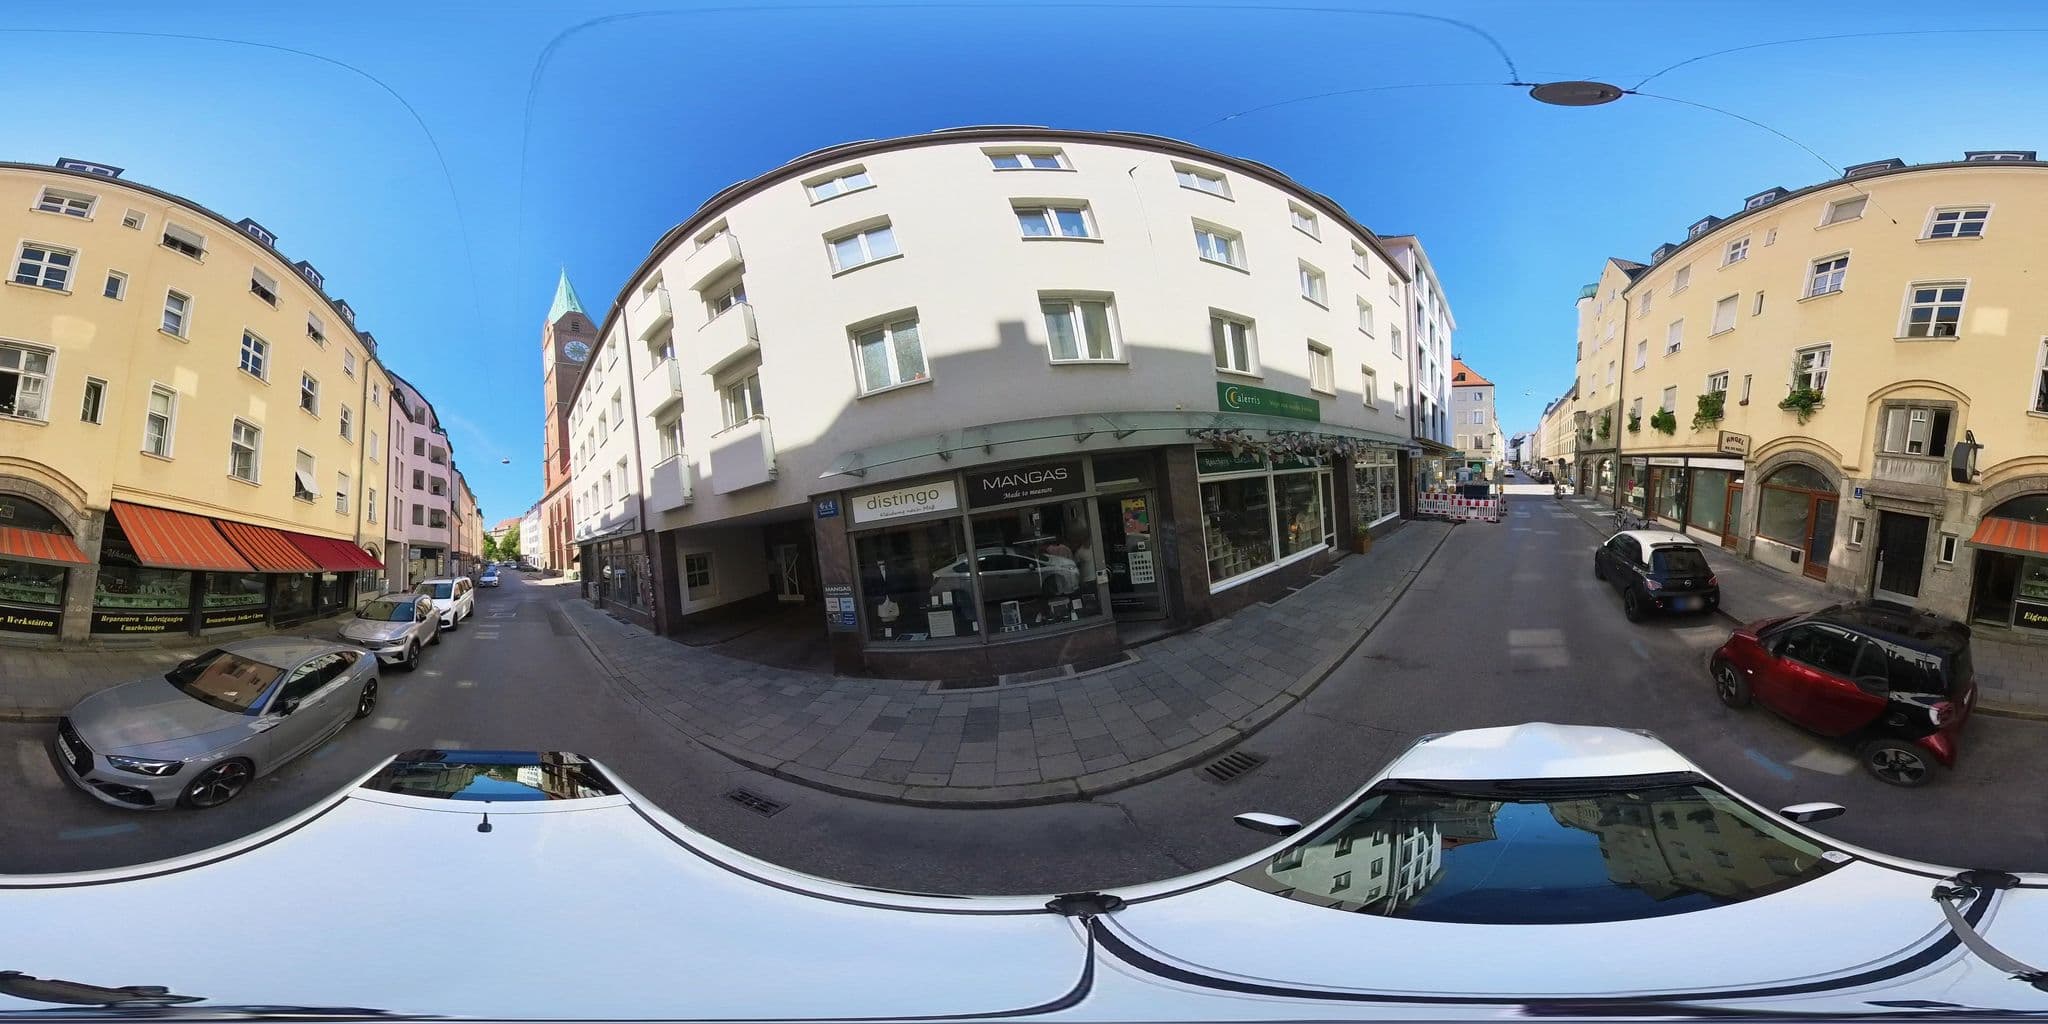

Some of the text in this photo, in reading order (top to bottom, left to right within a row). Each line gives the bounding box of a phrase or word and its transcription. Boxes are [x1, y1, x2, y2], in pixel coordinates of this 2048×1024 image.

[1726, 436, 1745, 446] ANGEL
[982, 467, 1068, 490] MANGAS
[1003, 490, 1021, 499] Made
[1029, 487, 1053, 495] measure
[866, 489, 939, 510] distingo
[2024, 611, 2048, 622] Eigen
